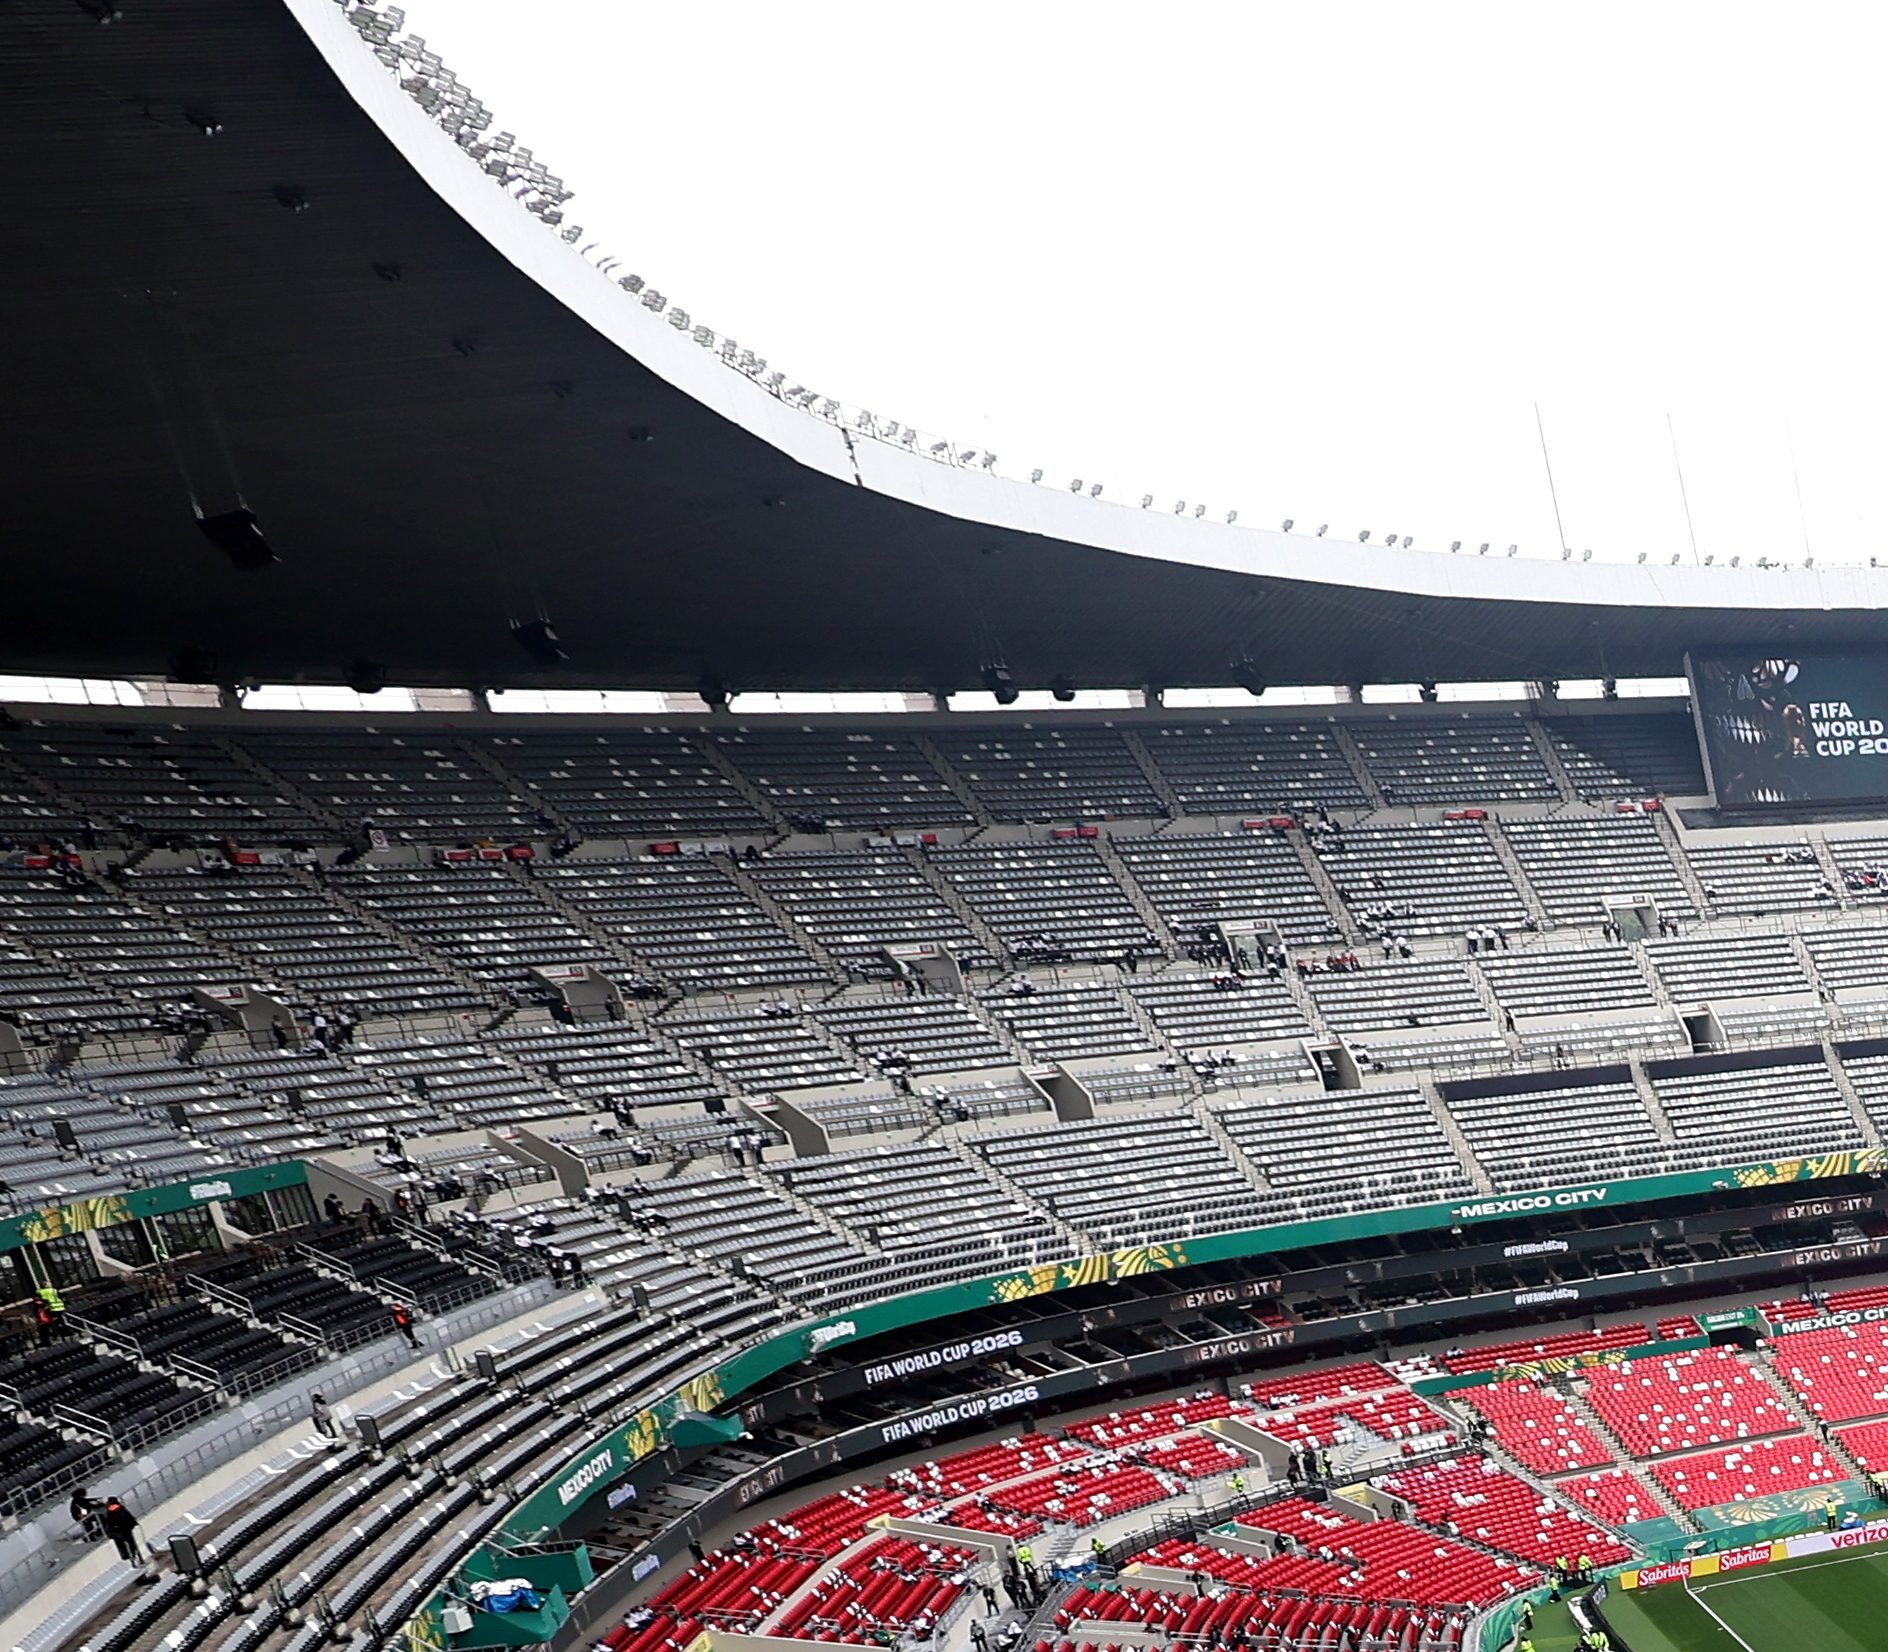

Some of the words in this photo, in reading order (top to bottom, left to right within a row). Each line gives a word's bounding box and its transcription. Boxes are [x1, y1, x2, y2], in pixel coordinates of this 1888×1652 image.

[1809, 701, 1853, 719] FIFA
[1811, 719, 1884, 738] WORLD
[1816, 739, 1856, 757] CUP
[1460, 1198, 1553, 1219] MEXICO
[1556, 1187, 1608, 1208] CITY
[1839, 1196, 1873, 1214] CITY
[1846, 1241, 1881, 1260] CITY
[1242, 1279, 1283, 1299] CITY
[1782, 1309, 1863, 1335] MEXICO
[1255, 1330, 1296, 1351] CITY
[865, 1364, 896, 1385] FIFA
[894, 1350, 942, 1378] WORLD
[942, 1342, 971, 1364] CUP
[970, 1329, 1024, 1358] 2026
[881, 1421, 912, 1444] FIFA
[910, 1407, 958, 1435] WORLD
[957, 1398, 988, 1421] CUP
[986, 1385, 1040, 1413] 2026
[557, 1465, 593, 1506] MEXICO
[589, 1449, 614, 1477] CITY
[1720, 1546, 1771, 1572] Sabritas
[1638, 1561, 1690, 1586] Sabritas
